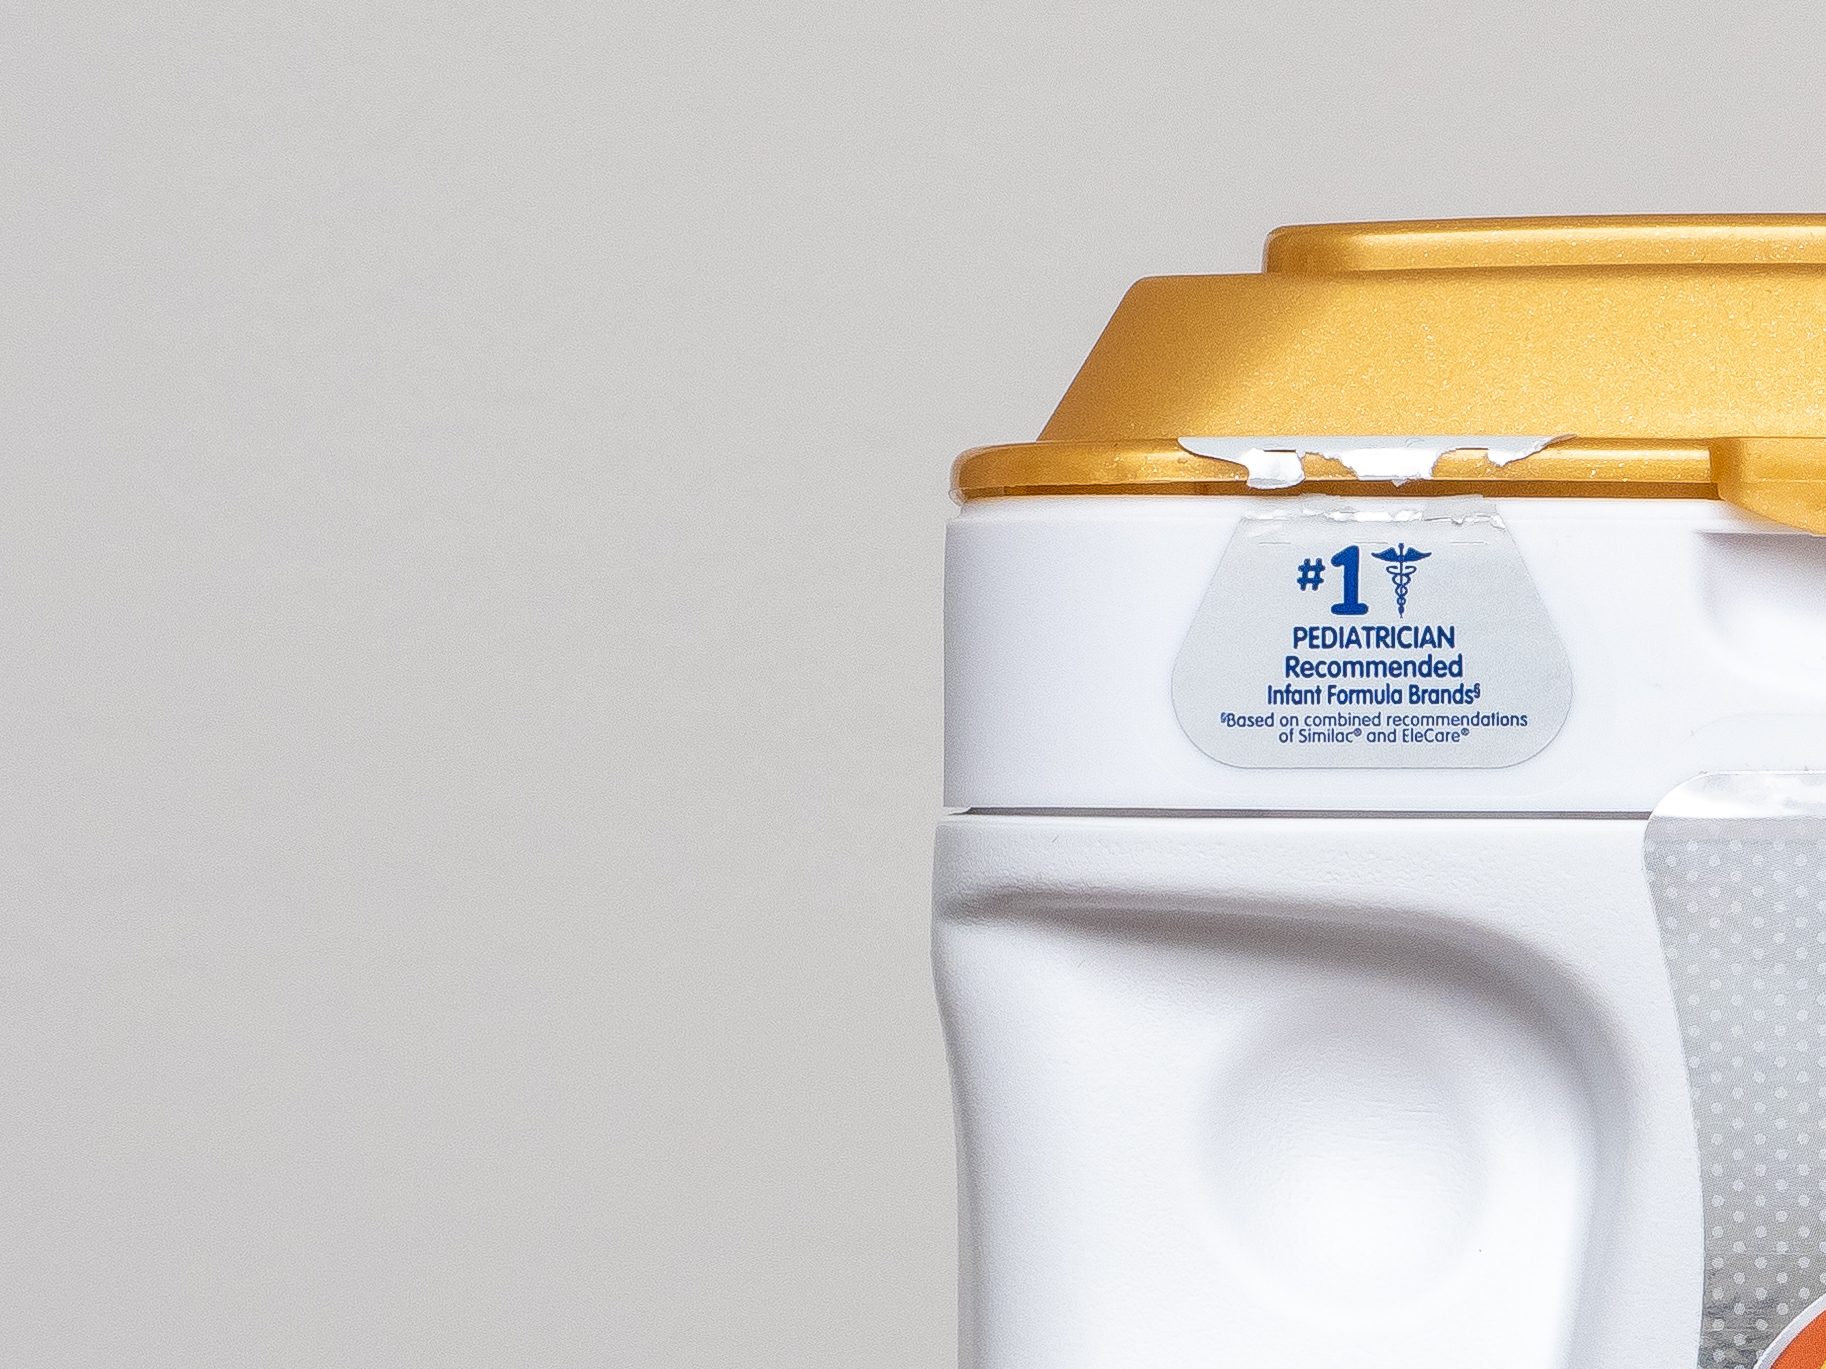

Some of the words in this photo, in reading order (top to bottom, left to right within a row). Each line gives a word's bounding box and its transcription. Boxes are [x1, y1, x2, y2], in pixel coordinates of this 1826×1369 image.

[1297, 545, 1369, 616] #1
[1293, 625, 1456, 649] PEDIATRICIAN
[1285, 653, 1464, 678] Recommended
[1267, 684, 1322, 705] Infant
[1328, 684, 1402, 705] Formula
[1280, 715, 1300, 728] on
[1304, 711, 1382, 728] combined
[1386, 711, 1528, 728] recommendations
[1278, 727, 1296, 744] of
[1366, 727, 1397, 743] and
